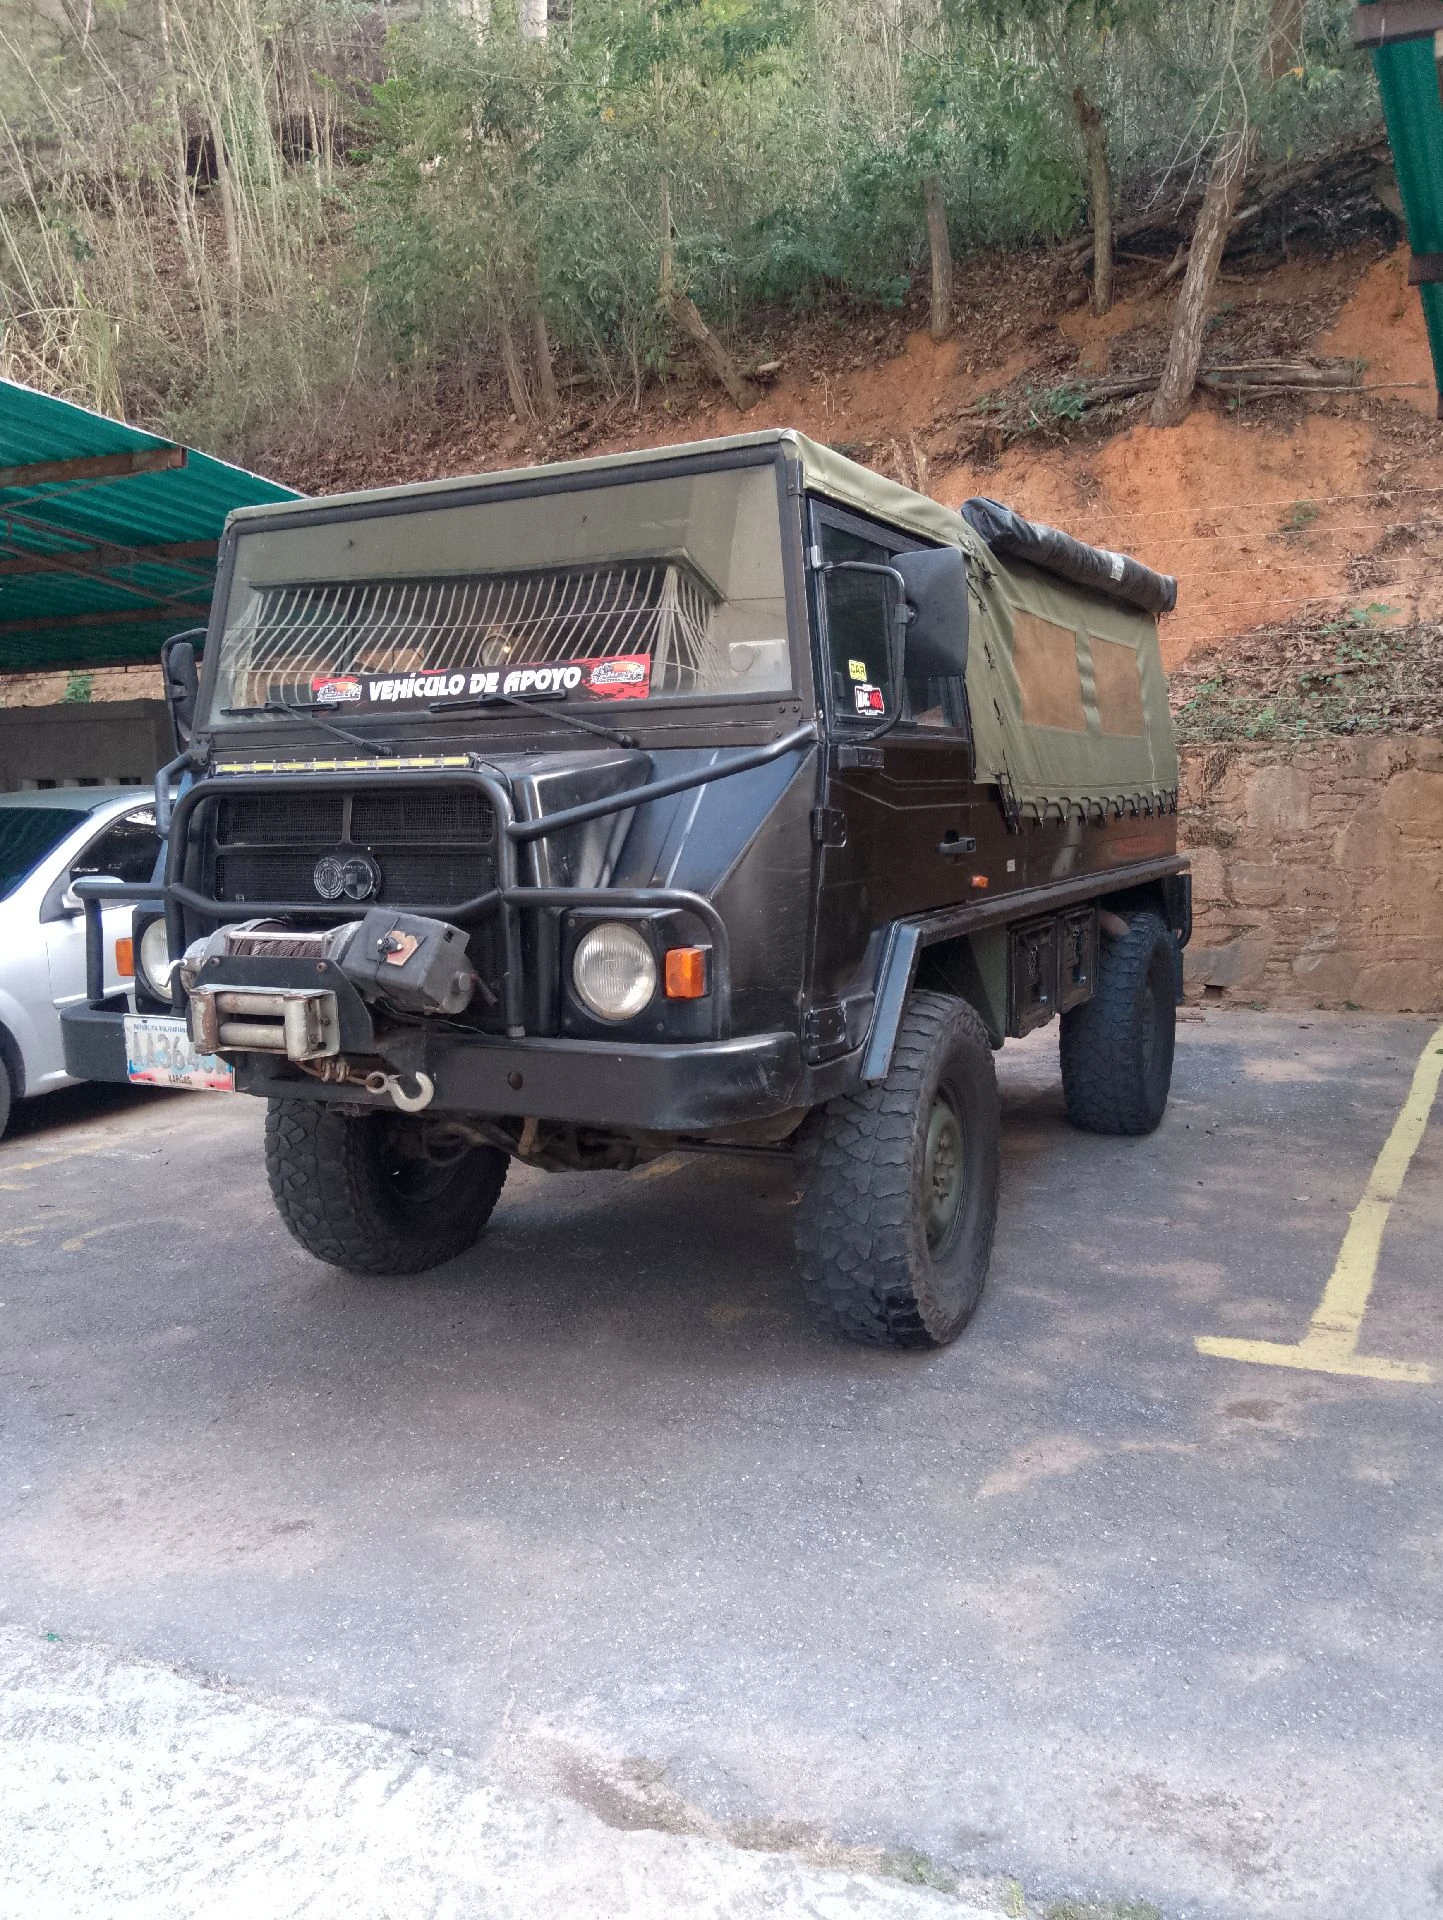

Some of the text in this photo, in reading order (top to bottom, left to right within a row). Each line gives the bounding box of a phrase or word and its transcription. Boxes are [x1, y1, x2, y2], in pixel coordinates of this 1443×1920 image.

[369, 667, 581, 702] VEHÍCULO DE APOYO
